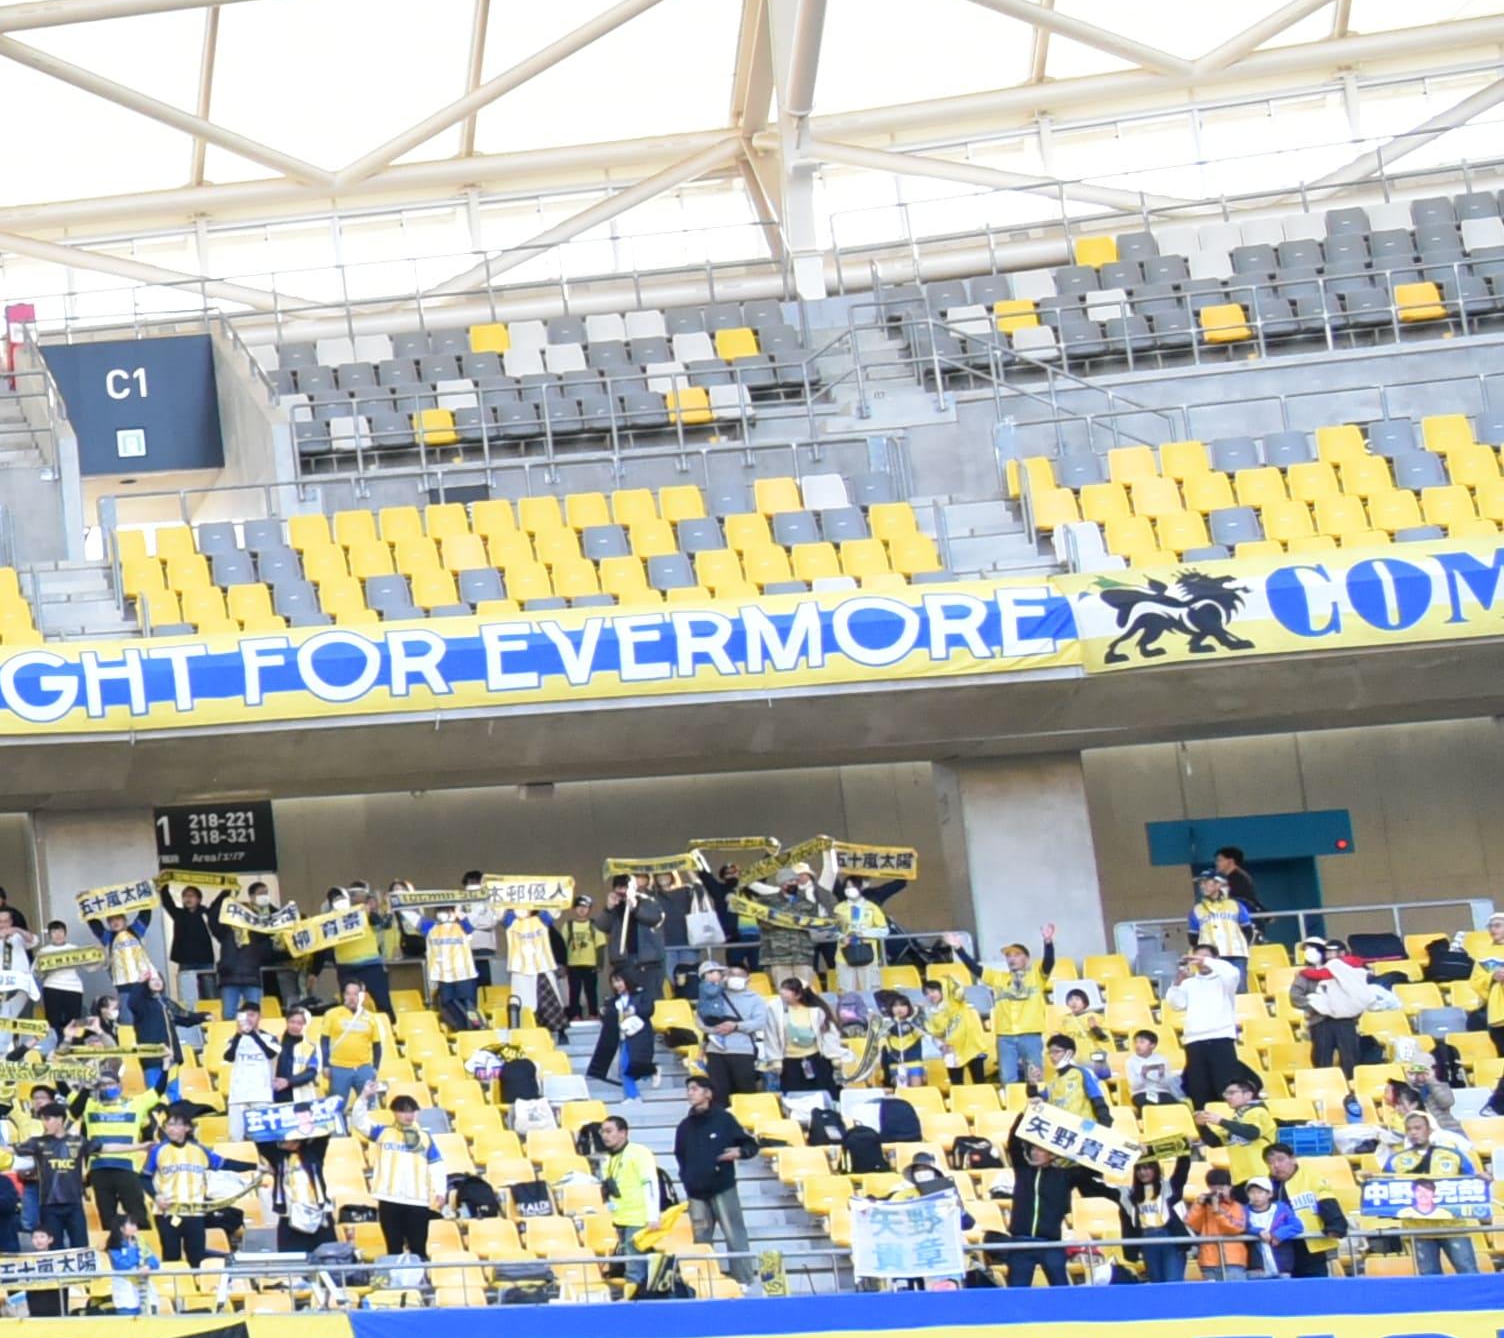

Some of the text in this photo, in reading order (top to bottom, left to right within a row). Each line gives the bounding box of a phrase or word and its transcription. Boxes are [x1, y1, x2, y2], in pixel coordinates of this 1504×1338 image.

[105, 367, 148, 400] C1
[238, 620, 454, 710] FOR
[481, 583, 1060, 698] EVERMORE
[189, 811, 255, 831] 218-221
[190, 827, 256, 846] 318-321
[1025, 1115, 1132, 1171] 矢野貴章
[50, 1159, 75, 1171] TKC
